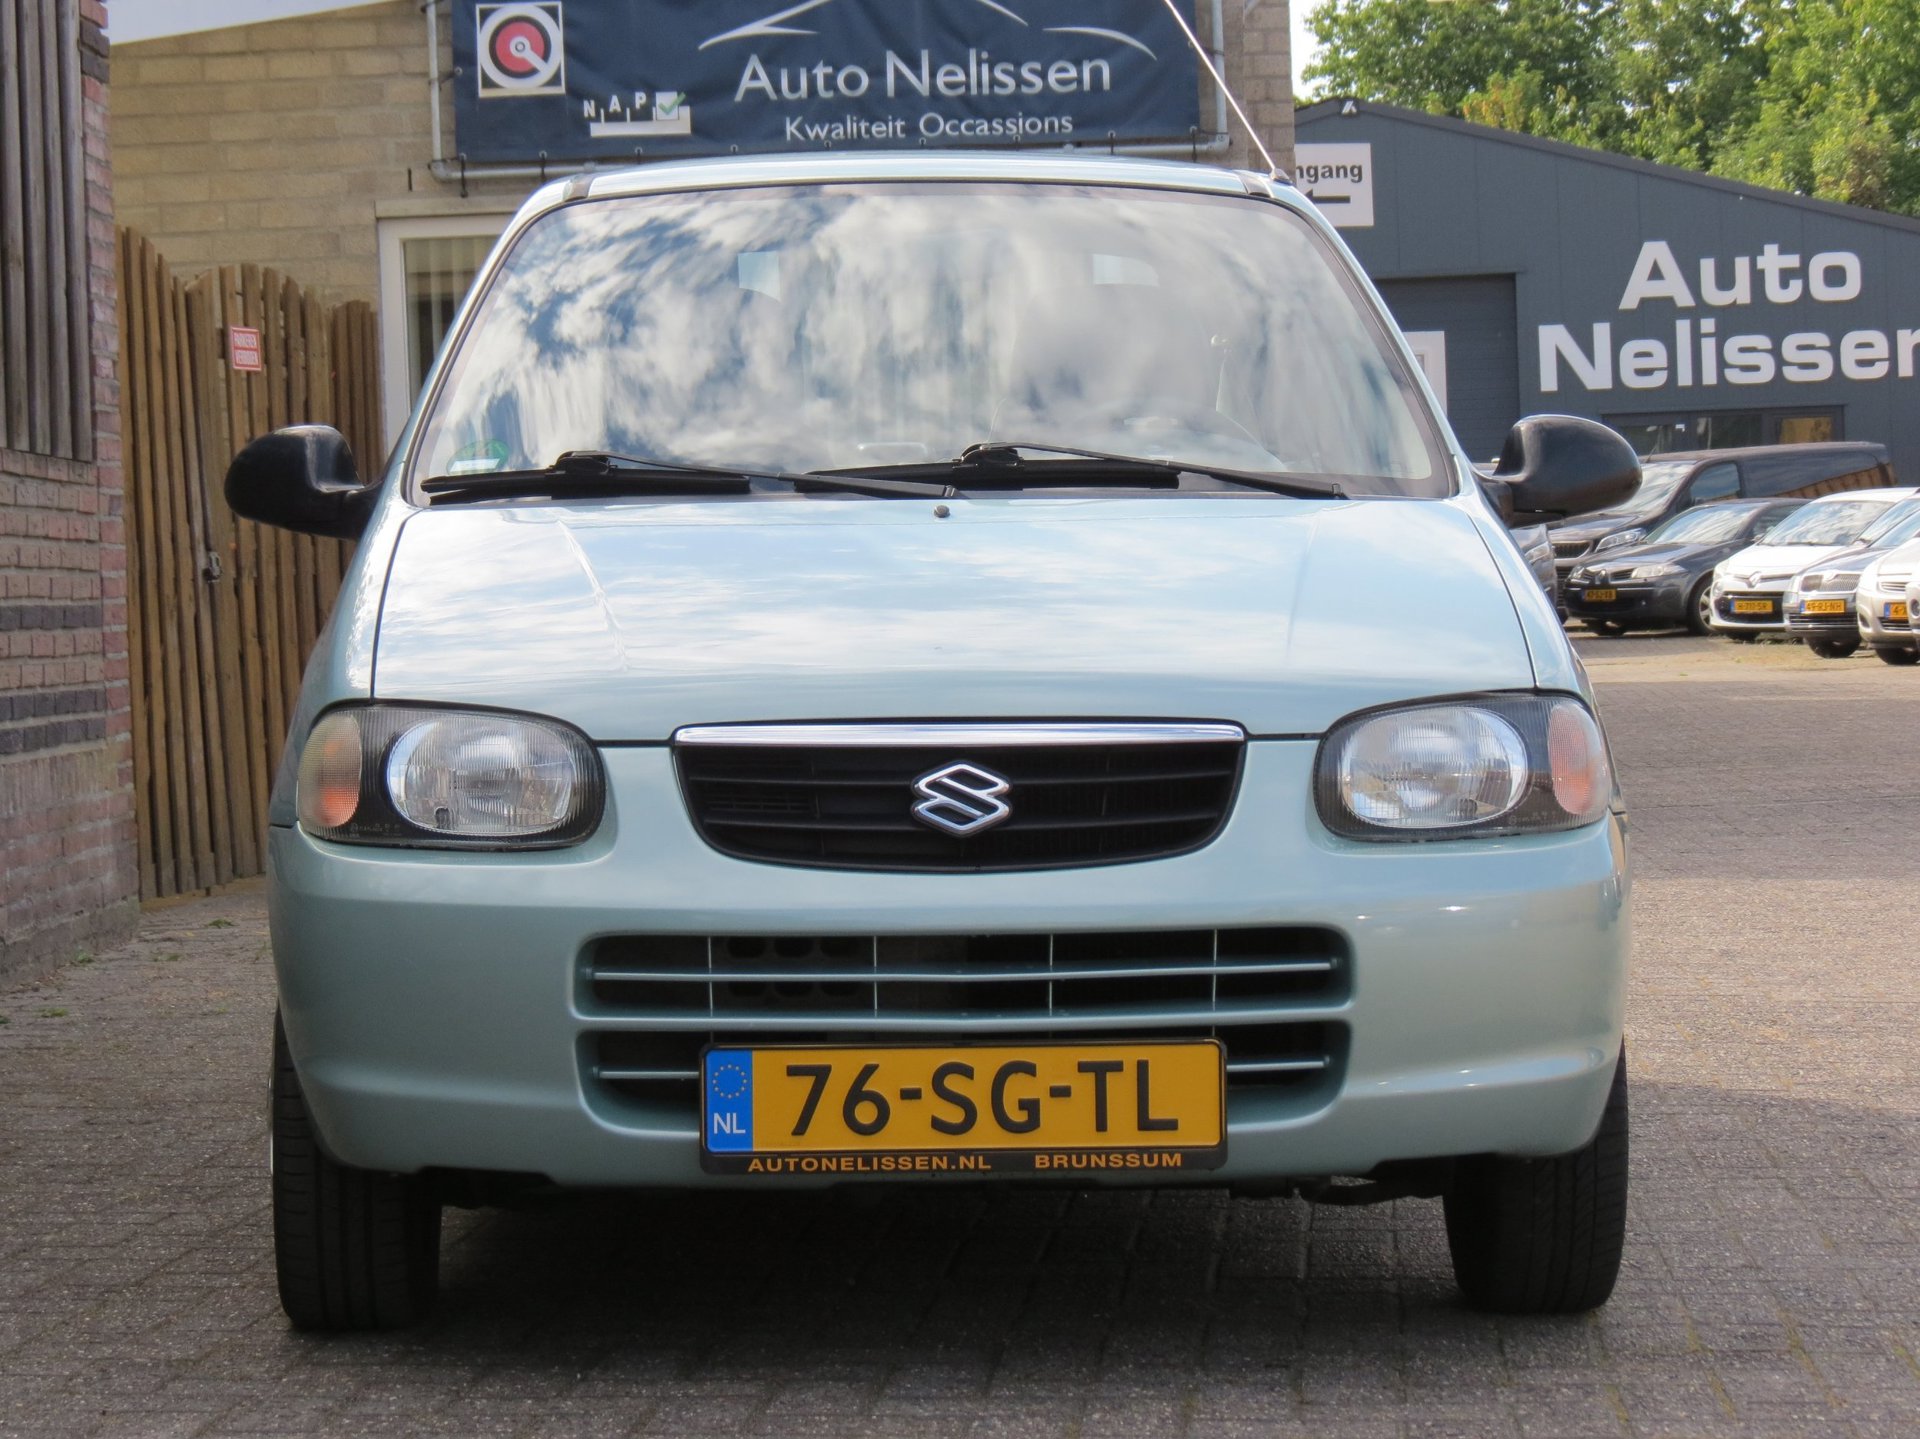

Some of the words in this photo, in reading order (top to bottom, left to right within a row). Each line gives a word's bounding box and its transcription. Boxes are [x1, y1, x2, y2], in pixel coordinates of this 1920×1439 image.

[734, 53, 870, 102] Auto
[885, 48, 1111, 98] Nelissen
[785, 114, 906, 142] Kwaliteit
[919, 111, 1074, 138] Occassions
[1618, 240, 1862, 311] Auto
[786, 1059, 1179, 1137] 76-SG-TL
[713, 1112, 746, 1135] NL
[748, 1155, 992, 1172] AUTONELISSEN.NL
[1034, 1153, 1182, 1169] BRUNSSUM
